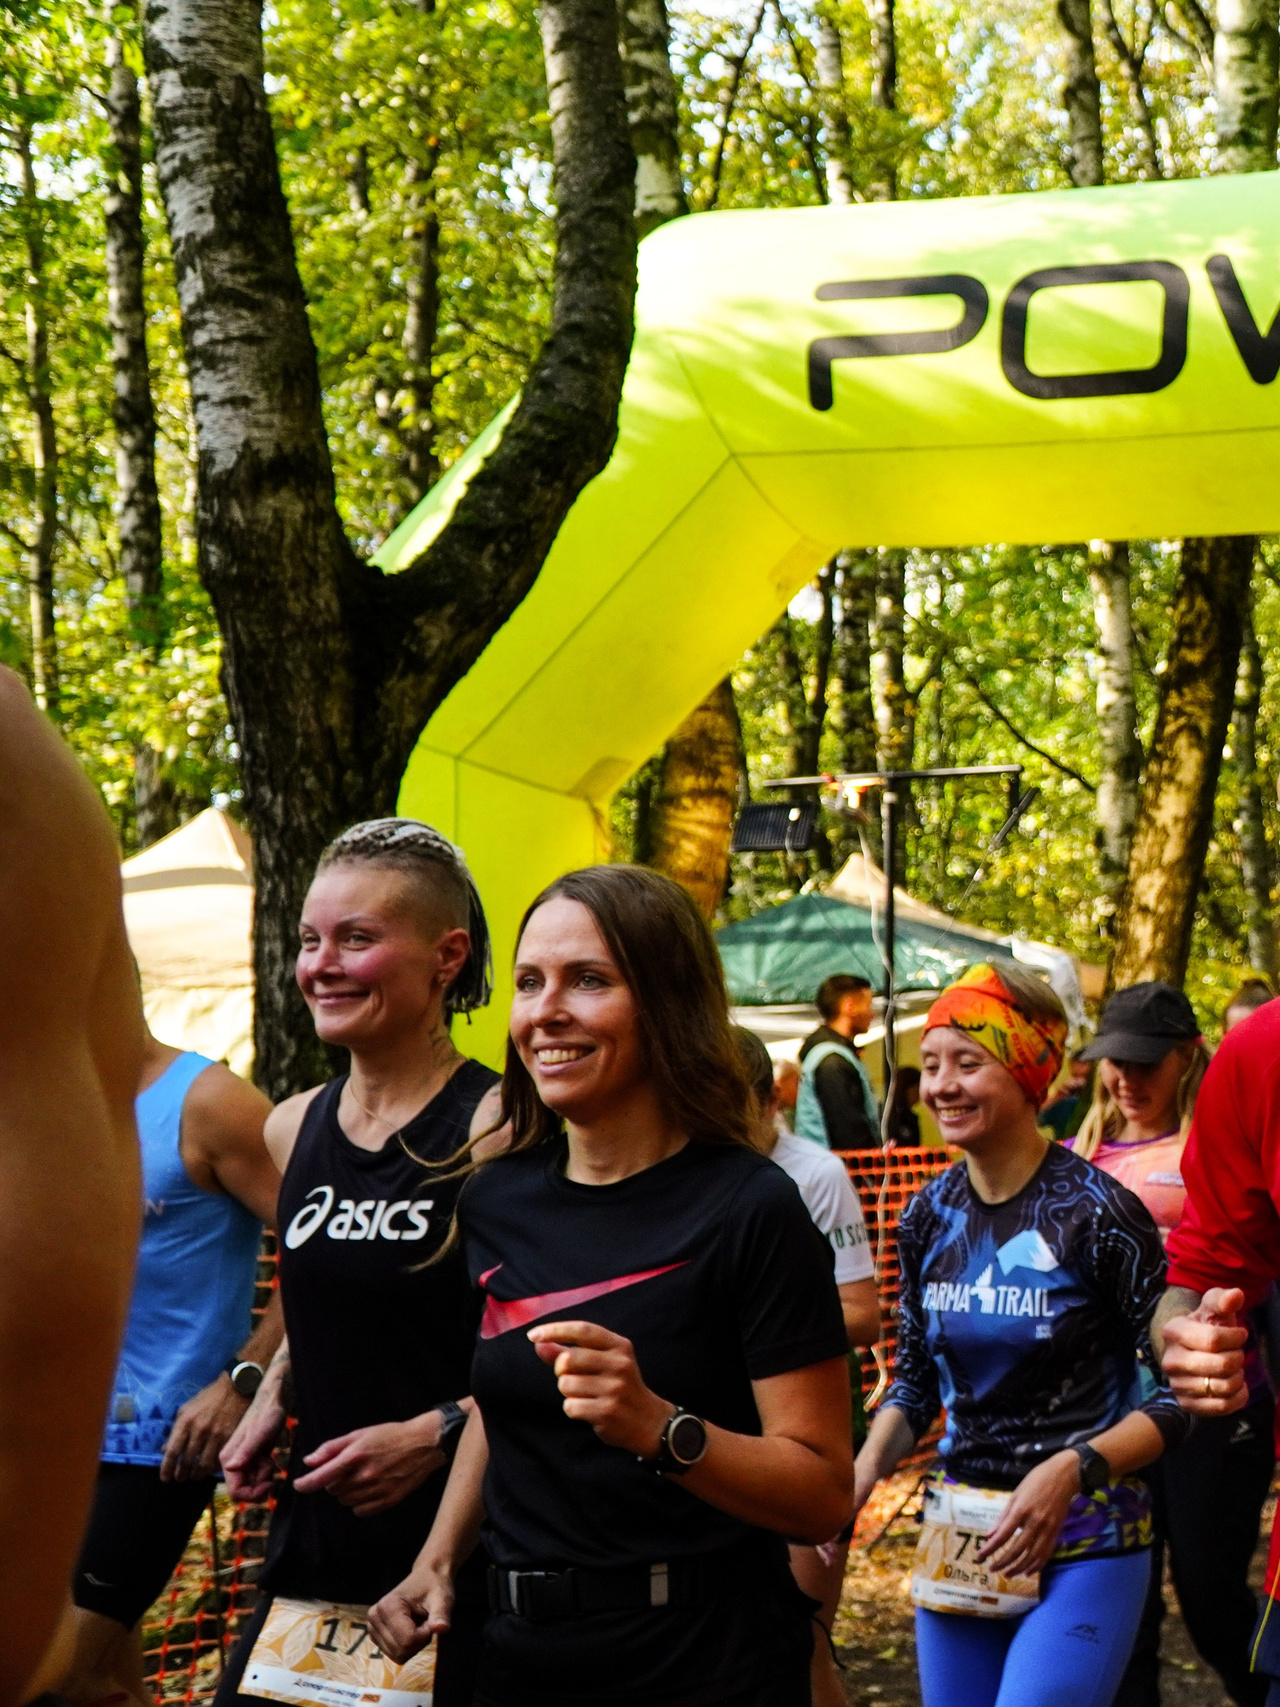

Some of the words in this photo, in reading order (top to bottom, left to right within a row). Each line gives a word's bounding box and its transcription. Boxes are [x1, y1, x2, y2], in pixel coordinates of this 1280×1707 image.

[921, 1281, 971, 1314] PARMA
[996, 1285, 1057, 1318] TRAIL
[315, 1616, 384, 1660] 17
